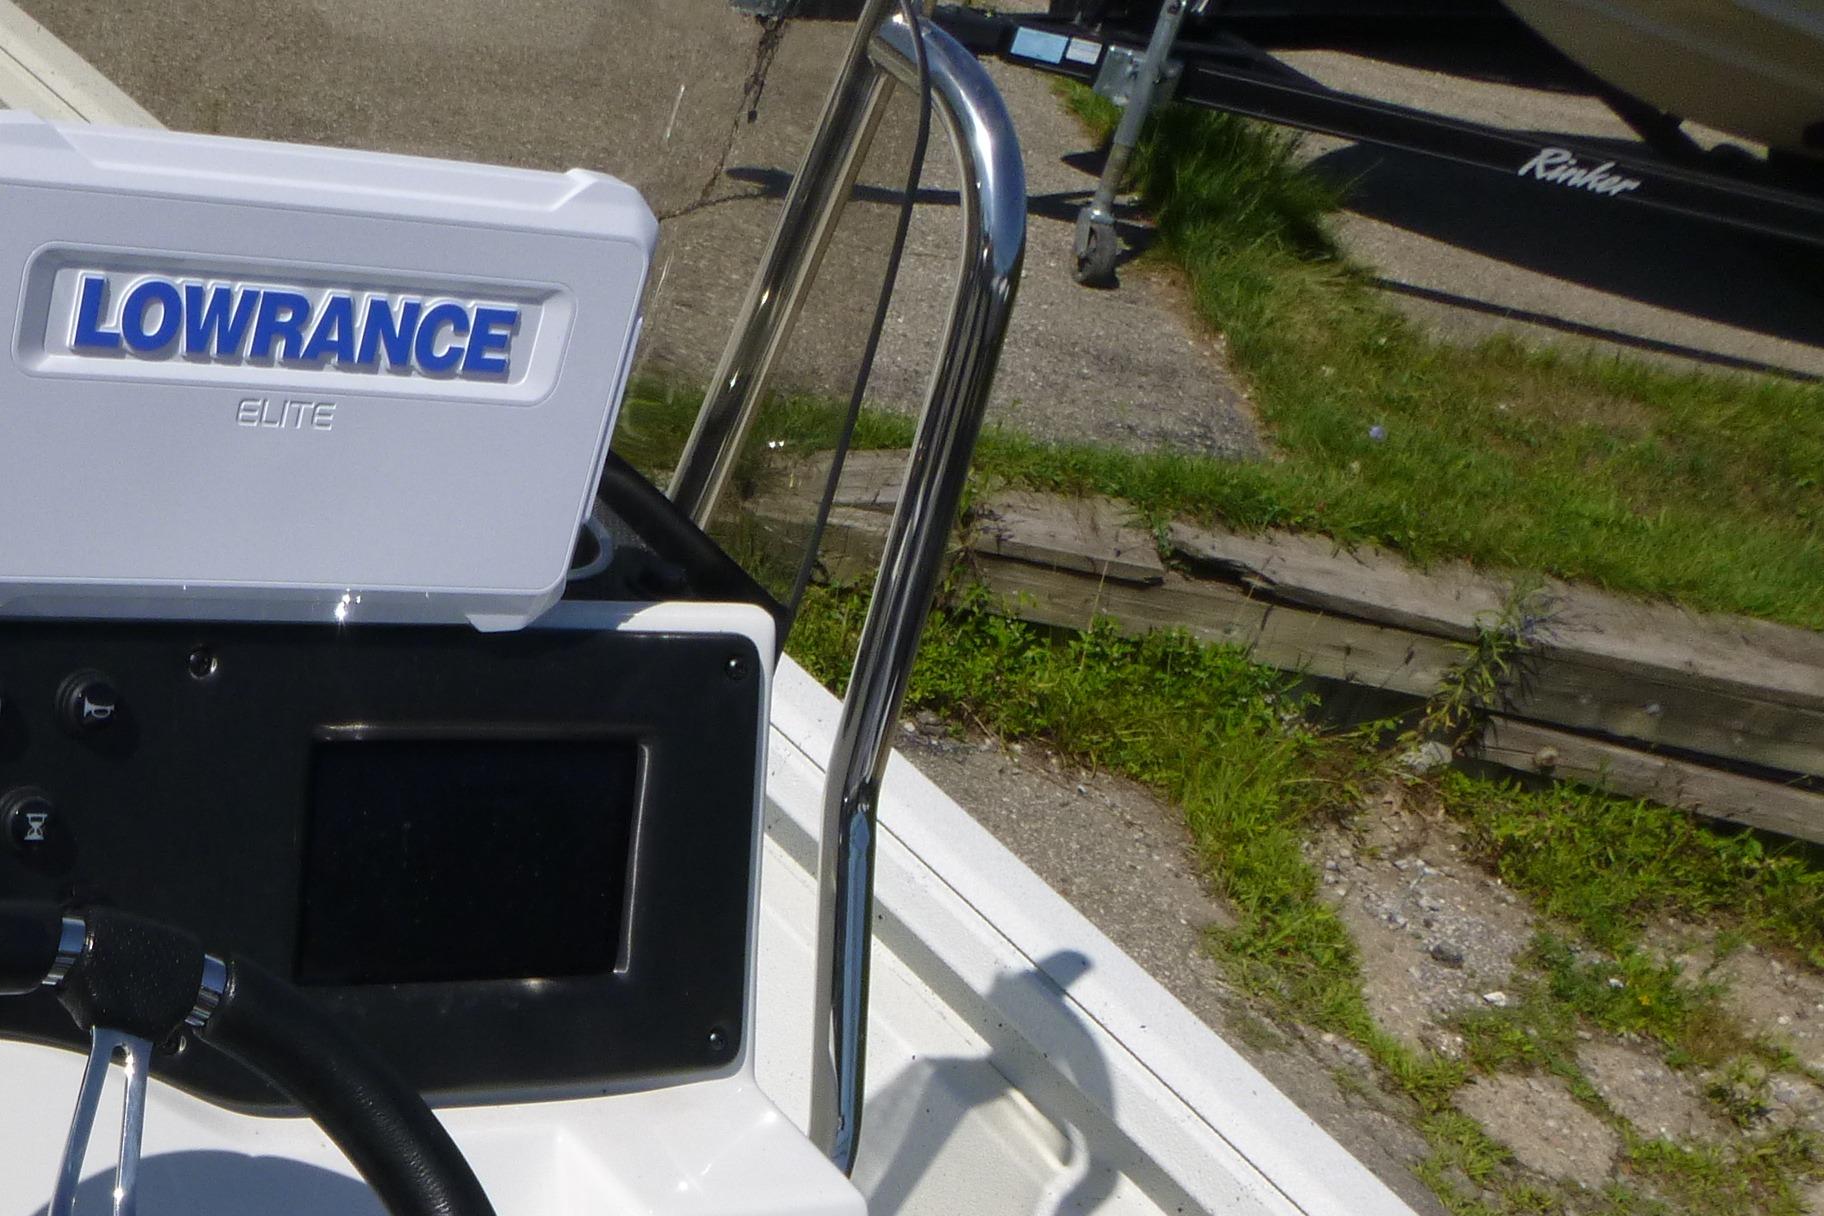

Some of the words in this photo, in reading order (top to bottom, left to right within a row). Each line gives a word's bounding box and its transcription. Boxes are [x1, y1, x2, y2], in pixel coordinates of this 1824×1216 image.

[1518, 147, 1641, 196] Rinker
[75, 276, 521, 376] LOWRANCE
[235, 398, 337, 430] ELITE
